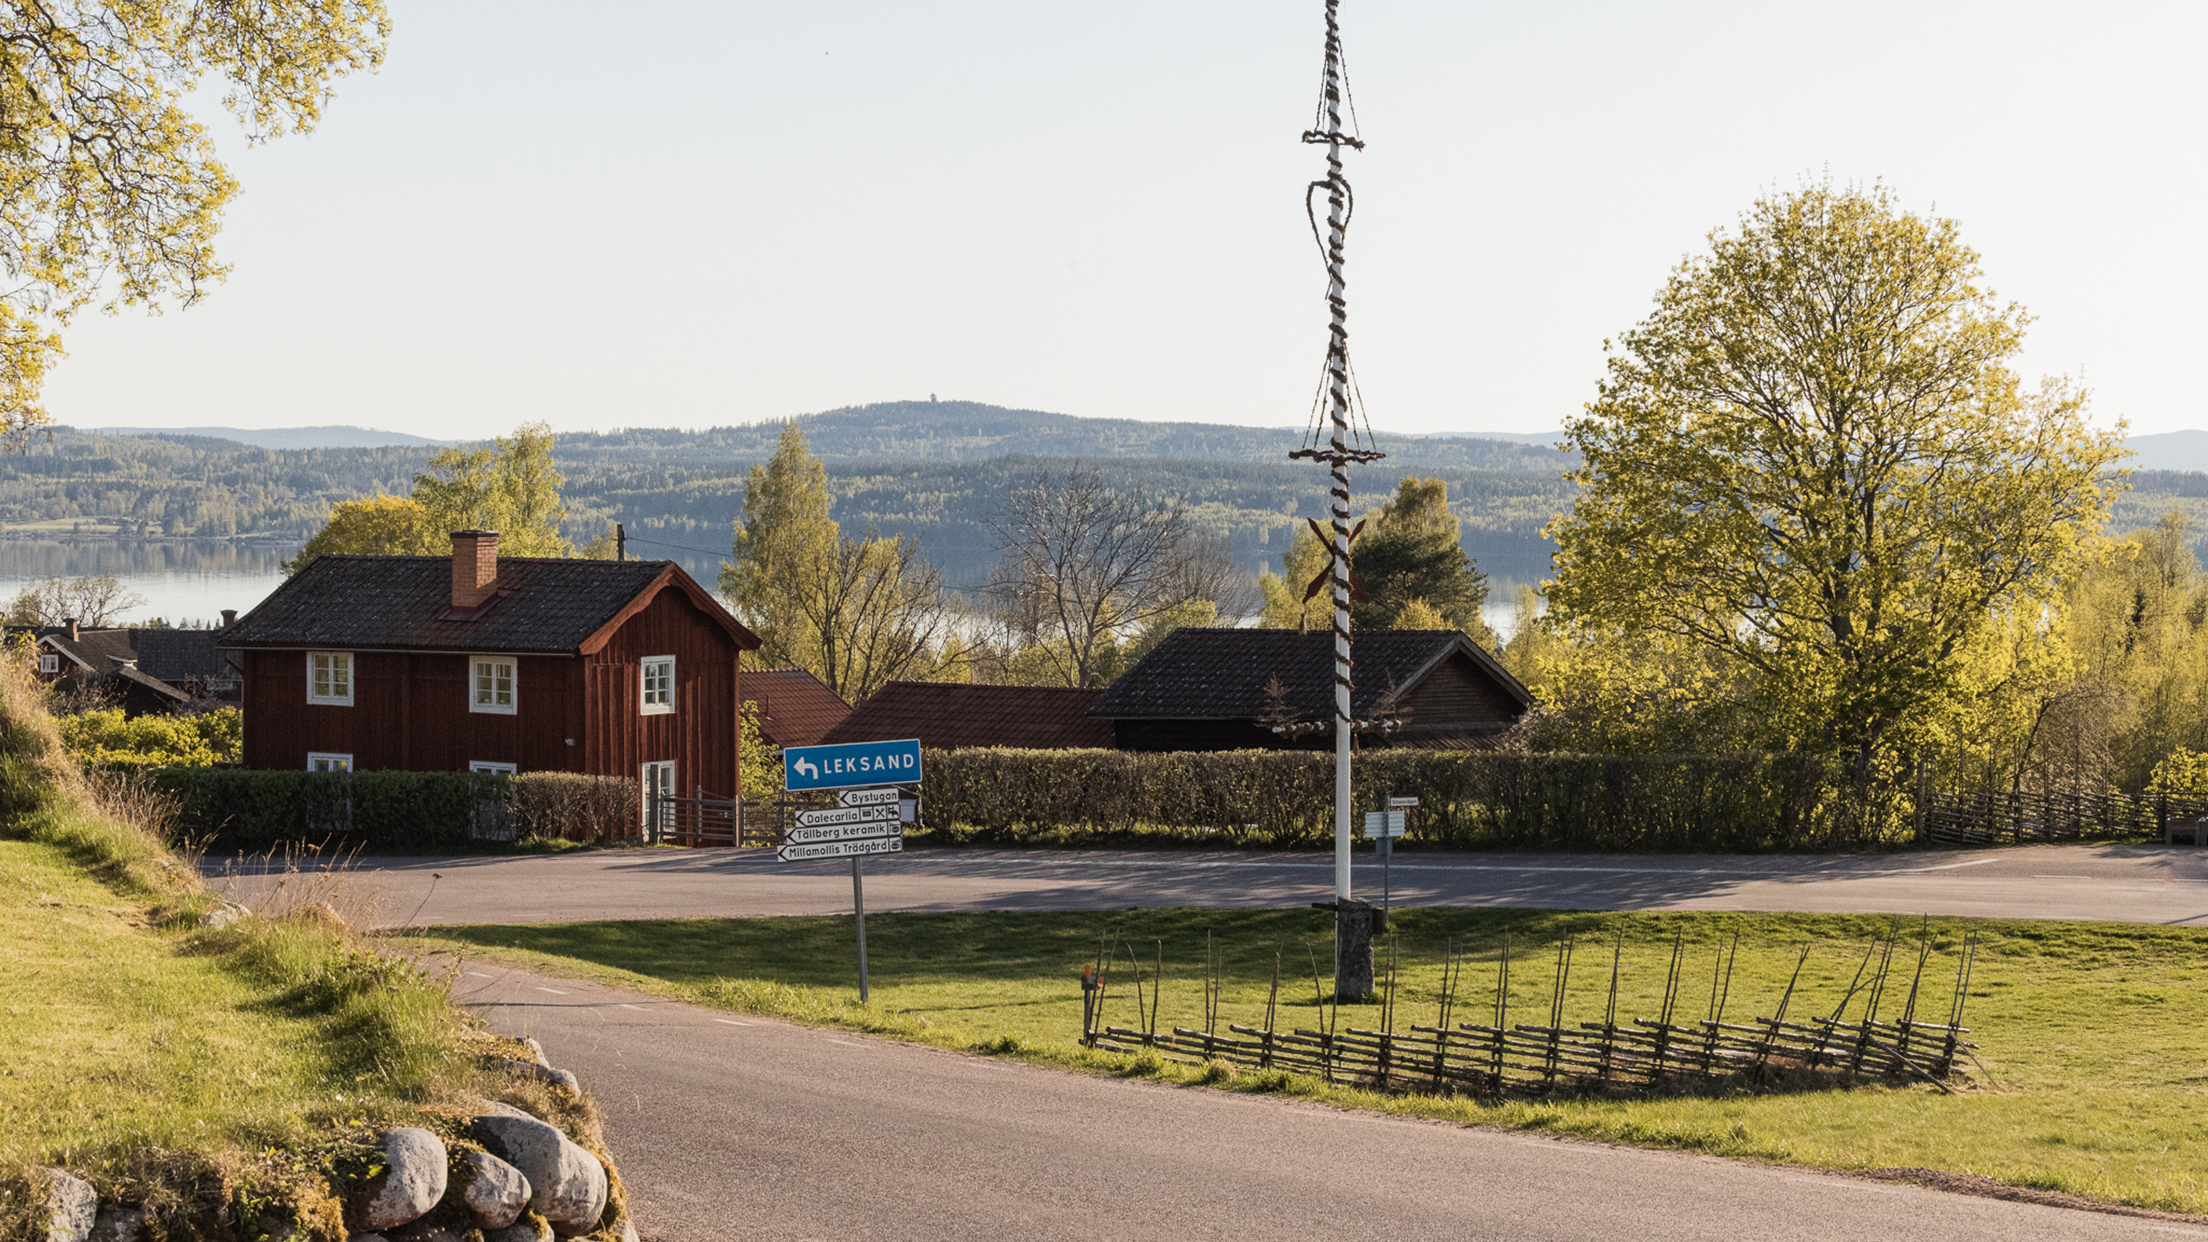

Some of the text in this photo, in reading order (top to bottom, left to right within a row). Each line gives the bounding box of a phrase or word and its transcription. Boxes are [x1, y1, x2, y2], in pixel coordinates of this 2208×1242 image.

[824, 754, 914, 774] LEKSAND
[851, 792, 897, 804] Bystugan
[807, 811, 858, 824] Dalecarlia
[796, 824, 886, 839] Tällberg keramik
[789, 841, 887, 858] Millamollis Trädgård
